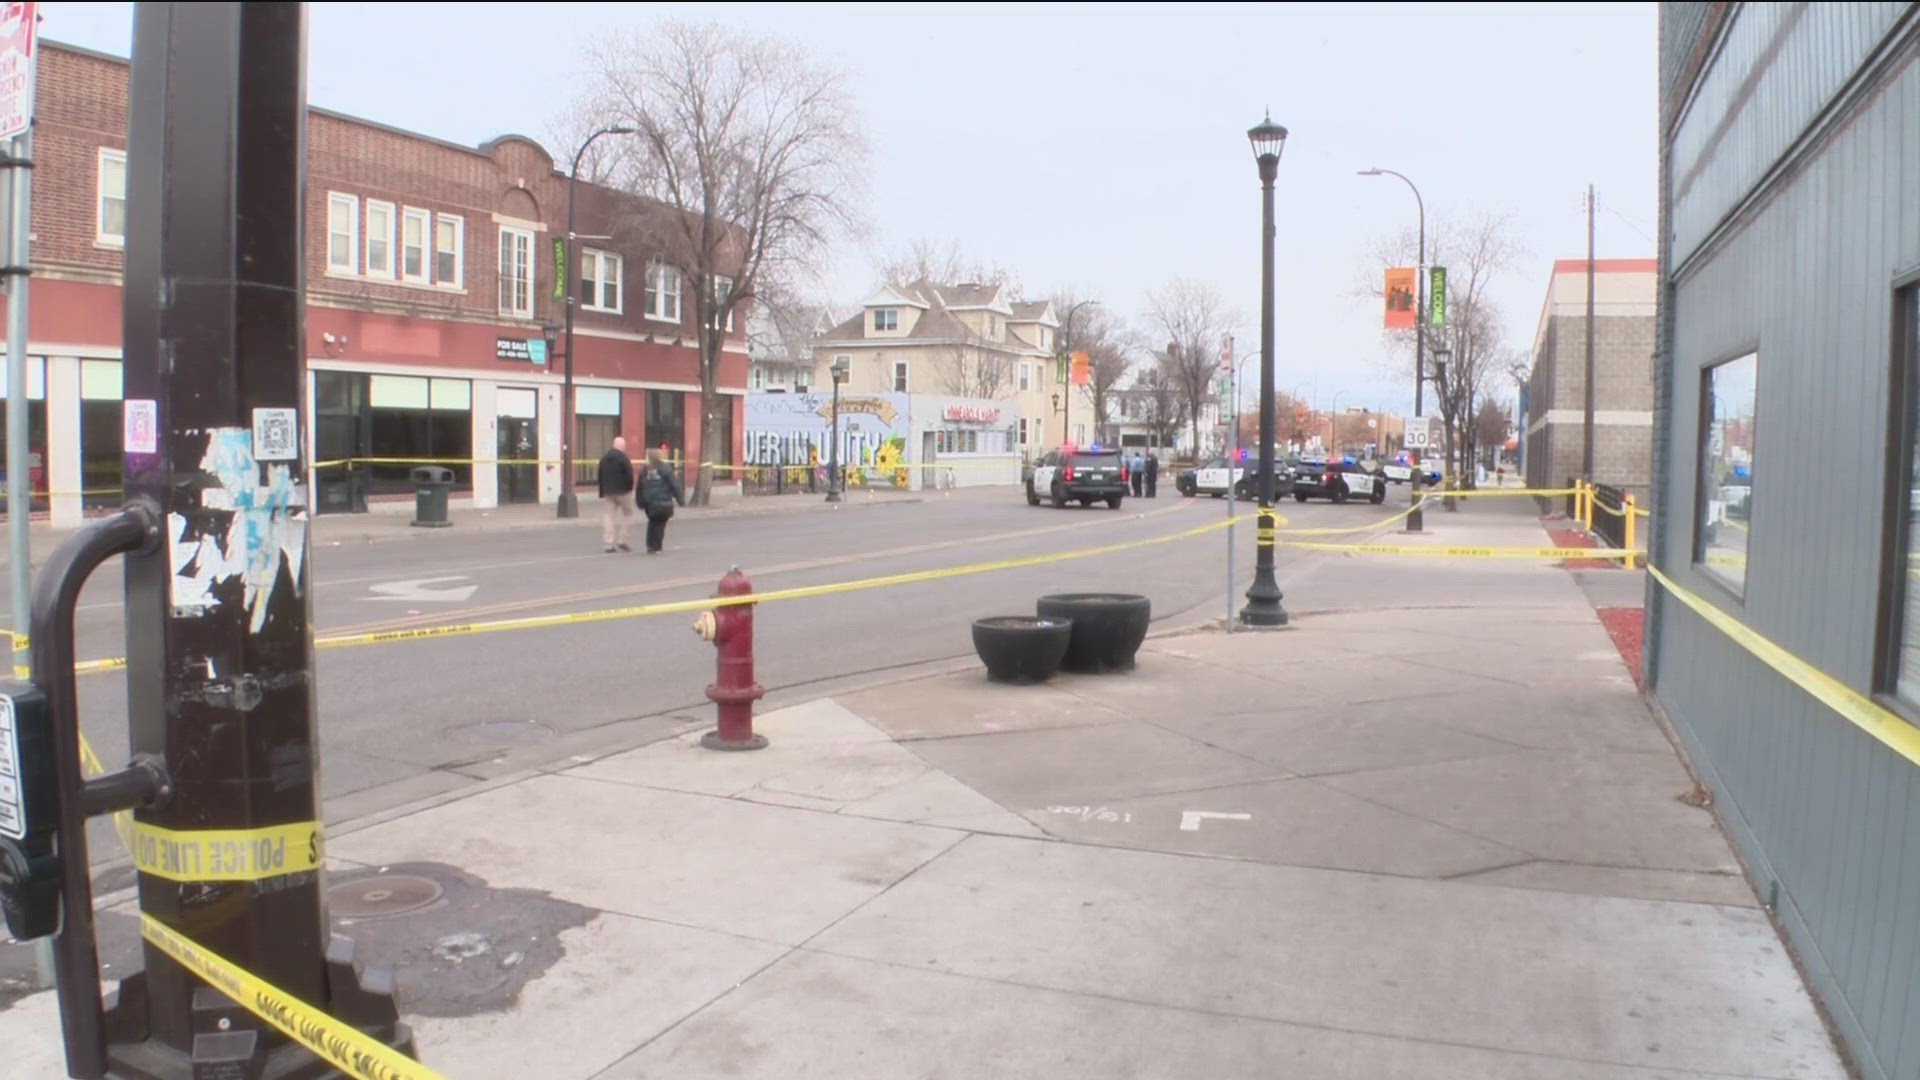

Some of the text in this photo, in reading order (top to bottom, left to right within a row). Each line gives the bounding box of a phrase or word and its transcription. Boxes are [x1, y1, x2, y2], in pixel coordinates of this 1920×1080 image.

[1432, 271, 1444, 324] WELCOME
[497, 340, 527, 351] FOR SALE
[1407, 432, 1427, 445] 30
[162, 836, 201, 874] LINE
[209, 835, 286, 875] POLICE
